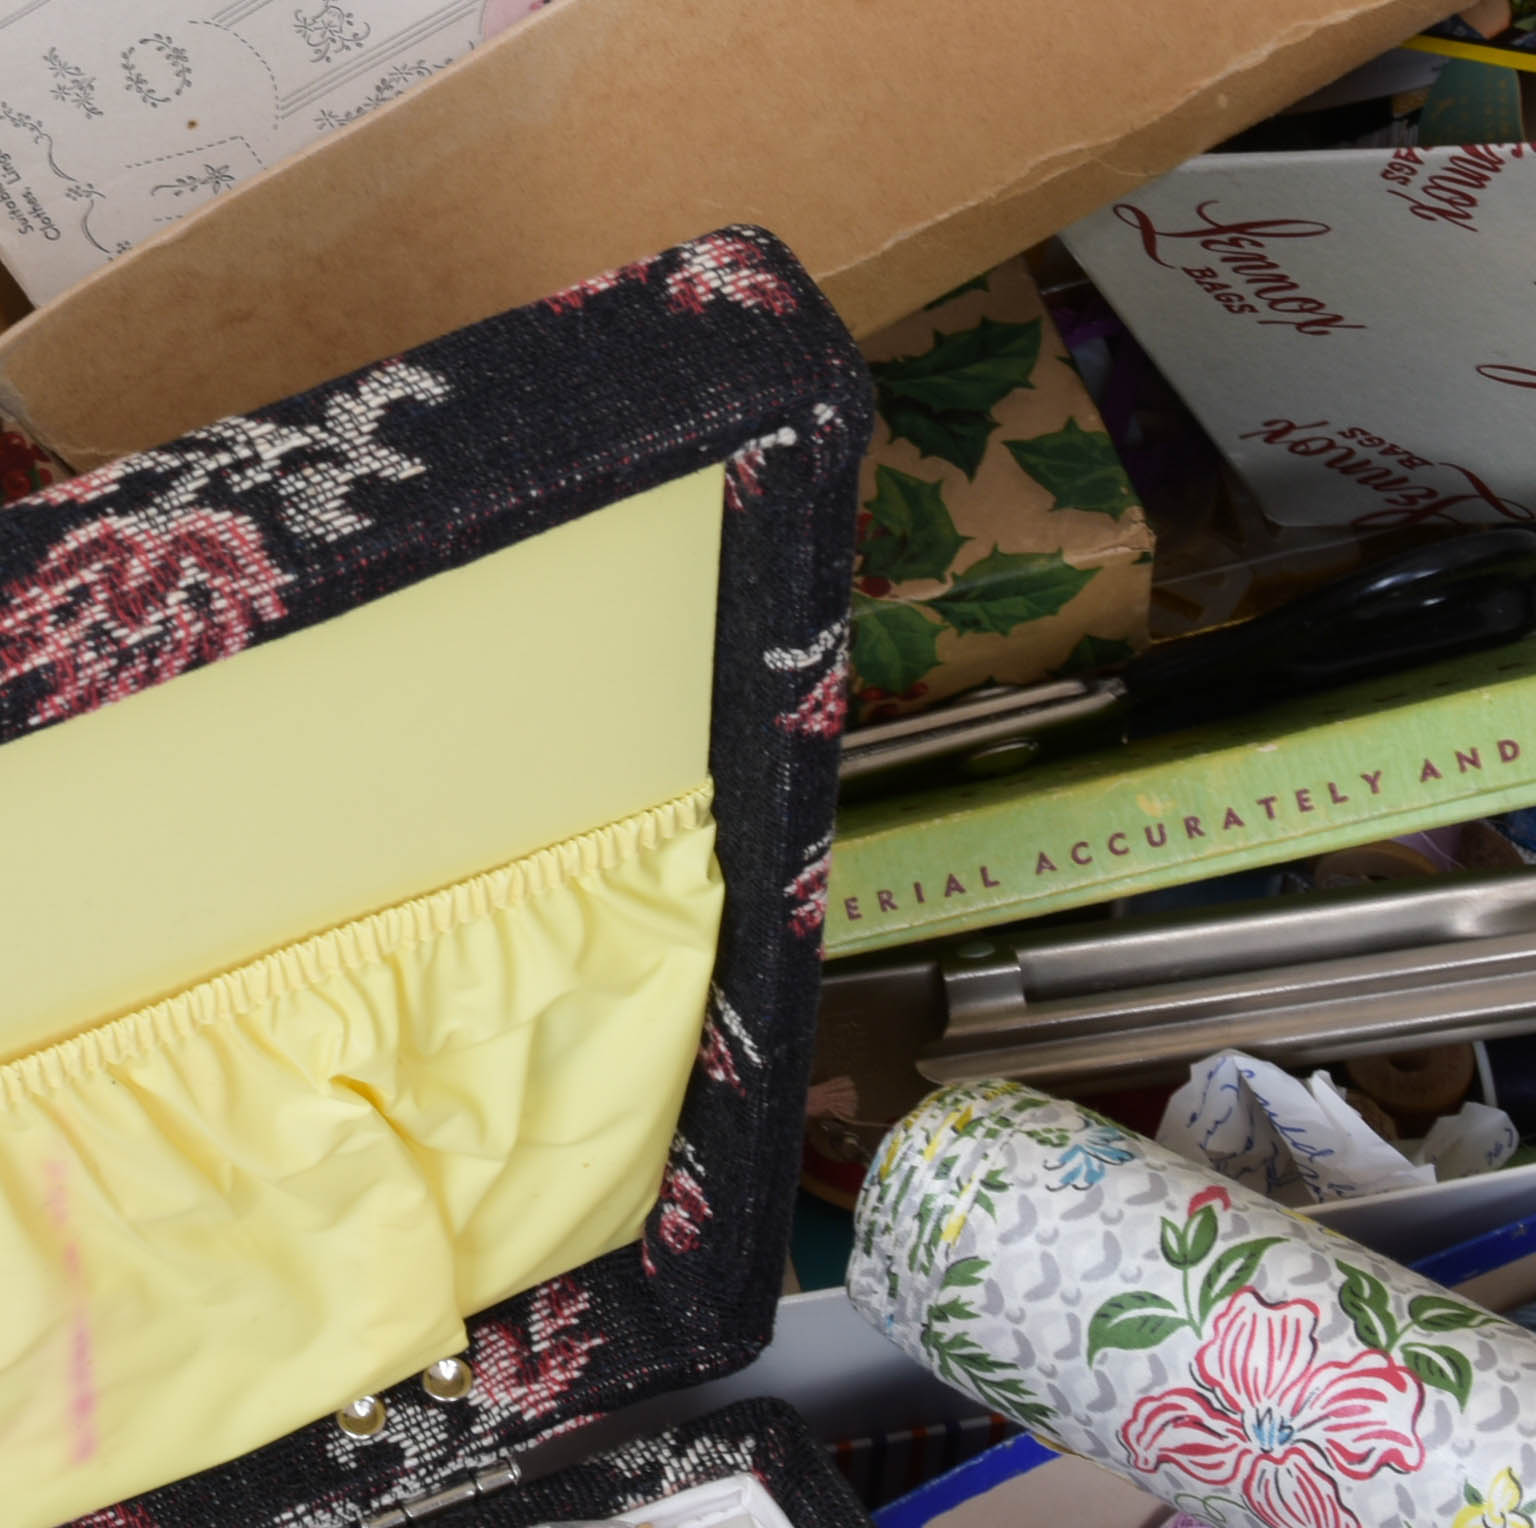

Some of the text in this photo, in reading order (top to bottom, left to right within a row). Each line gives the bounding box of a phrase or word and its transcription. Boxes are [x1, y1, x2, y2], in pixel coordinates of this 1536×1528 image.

[22, 186, 62, 241] Clothes,
[1111, 200, 1369, 337] Lennox
[1182, 265, 1258, 317] BAGS
[1337, 425, 1435, 470] BAGS
[1034, 766, 1385, 876] ACCURATELY
[1418, 736, 1523, 783] AND
